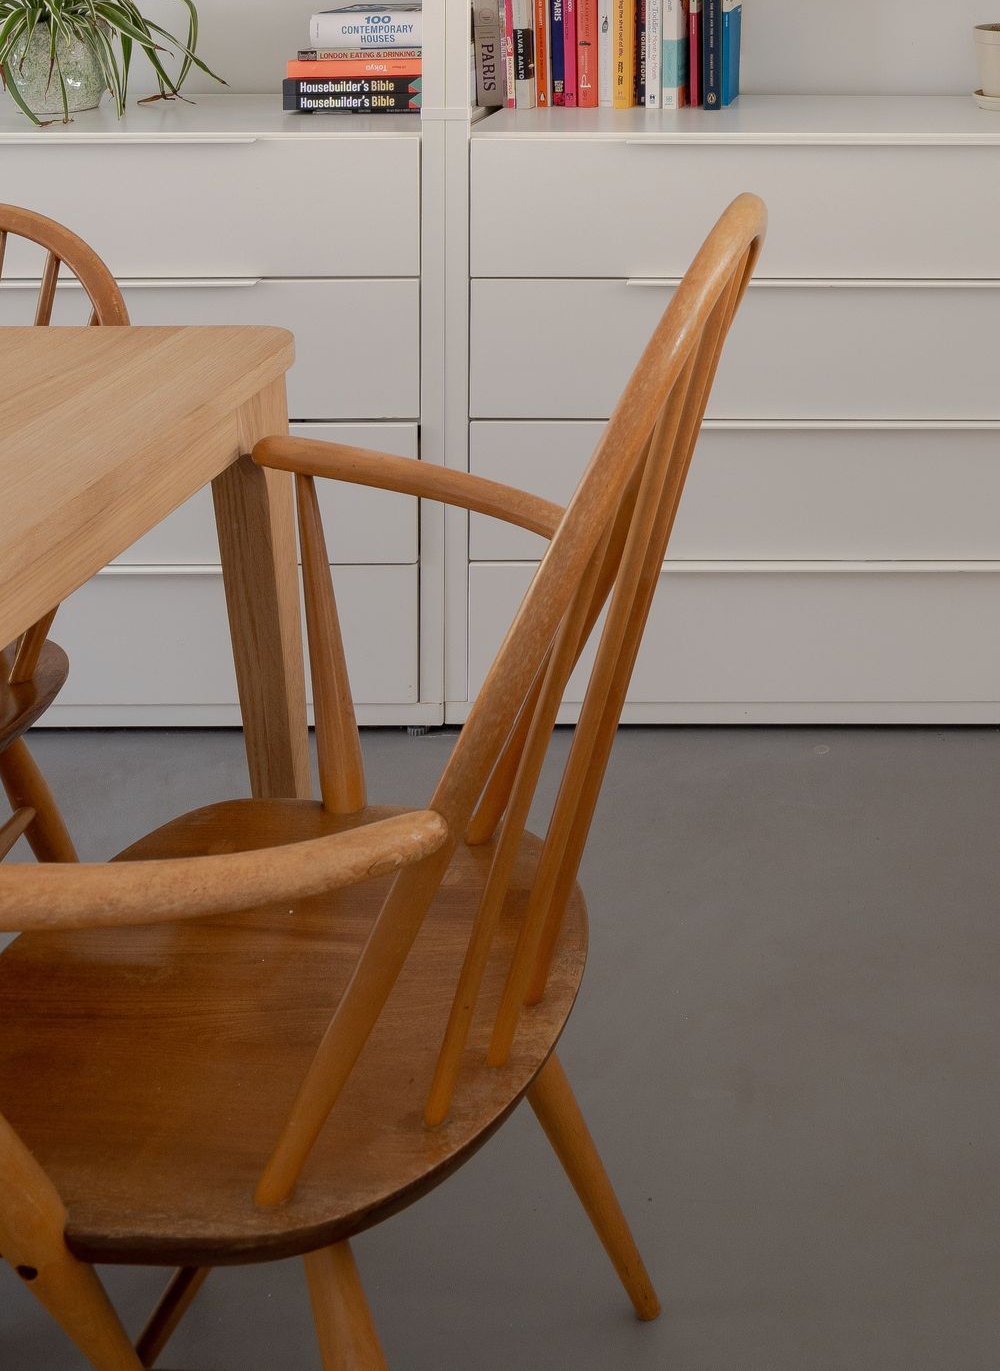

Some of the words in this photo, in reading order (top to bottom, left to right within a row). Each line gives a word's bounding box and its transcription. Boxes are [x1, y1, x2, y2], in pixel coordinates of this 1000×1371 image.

[364, 15, 392, 25] 100
[651, 7, 659, 33] Toddler
[341, 24, 414, 35] CONTEMPORARY
[360, 34, 396, 43] HOUSES
[516, 29, 524, 53] ALVAR
[350, 51, 374, 59] EATING
[383, 50, 416, 58] DRINKING
[365, 64, 388, 72] Tokyo
[481, 43, 496, 91] PARIS
[517, 55, 525, 80] AALTO
[370, 80, 395, 91] Bible
[371, 95, 396, 107] Bible
